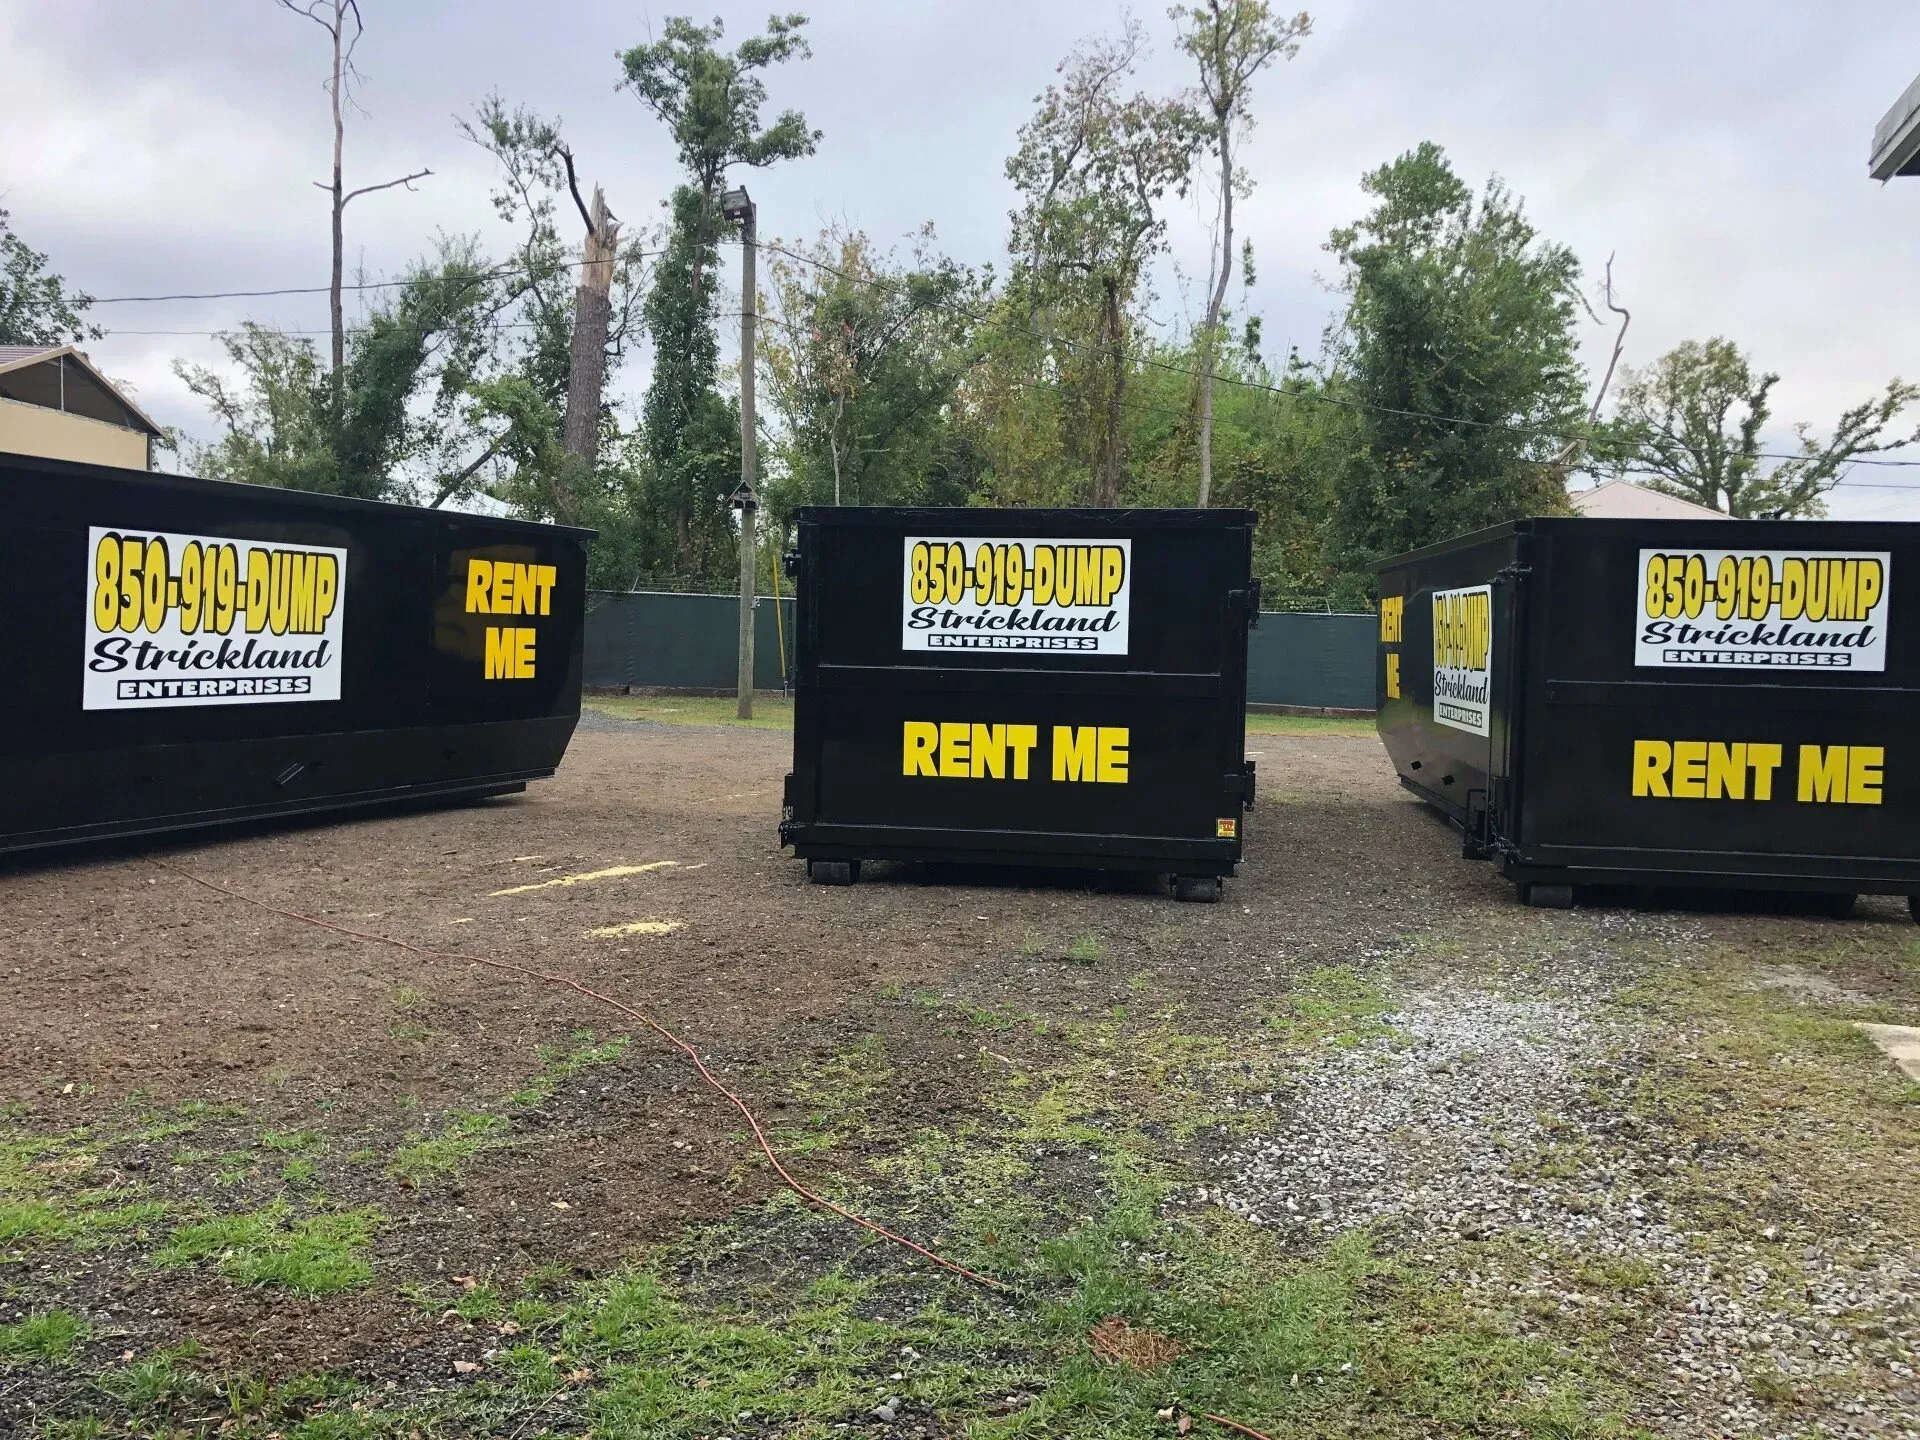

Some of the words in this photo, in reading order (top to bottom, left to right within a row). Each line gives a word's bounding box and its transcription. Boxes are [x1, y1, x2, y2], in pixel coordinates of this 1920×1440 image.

[94, 531, 339, 636] 850-919-DUMP
[465, 559, 557, 616] RENT
[910, 541, 1126, 607] 850-919-DUMP
[1644, 553, 1883, 622] 850-919-DUMP
[908, 607, 1119, 633] Strickland
[930, 635, 1098, 650] ENTERPRISES
[1381, 596, 1404, 643] RENT
[1641, 621, 1874, 650] Strickland
[88, 637, 333, 673] Strickland
[484, 627, 536, 680] ME
[1386, 653, 1401, 700] ME
[1665, 650, 1851, 666] ENTERPRISES
[118, 677, 311, 700] ENTERPRISES
[1434, 670, 1489, 705] Strickland
[1439, 703, 1483, 728] ENTERPRISES
[902, 721, 1038, 780] RENT
[1052, 725, 1130, 784] ME
[1632, 739, 1782, 801] RENT
[1798, 744, 1885, 805] ME
